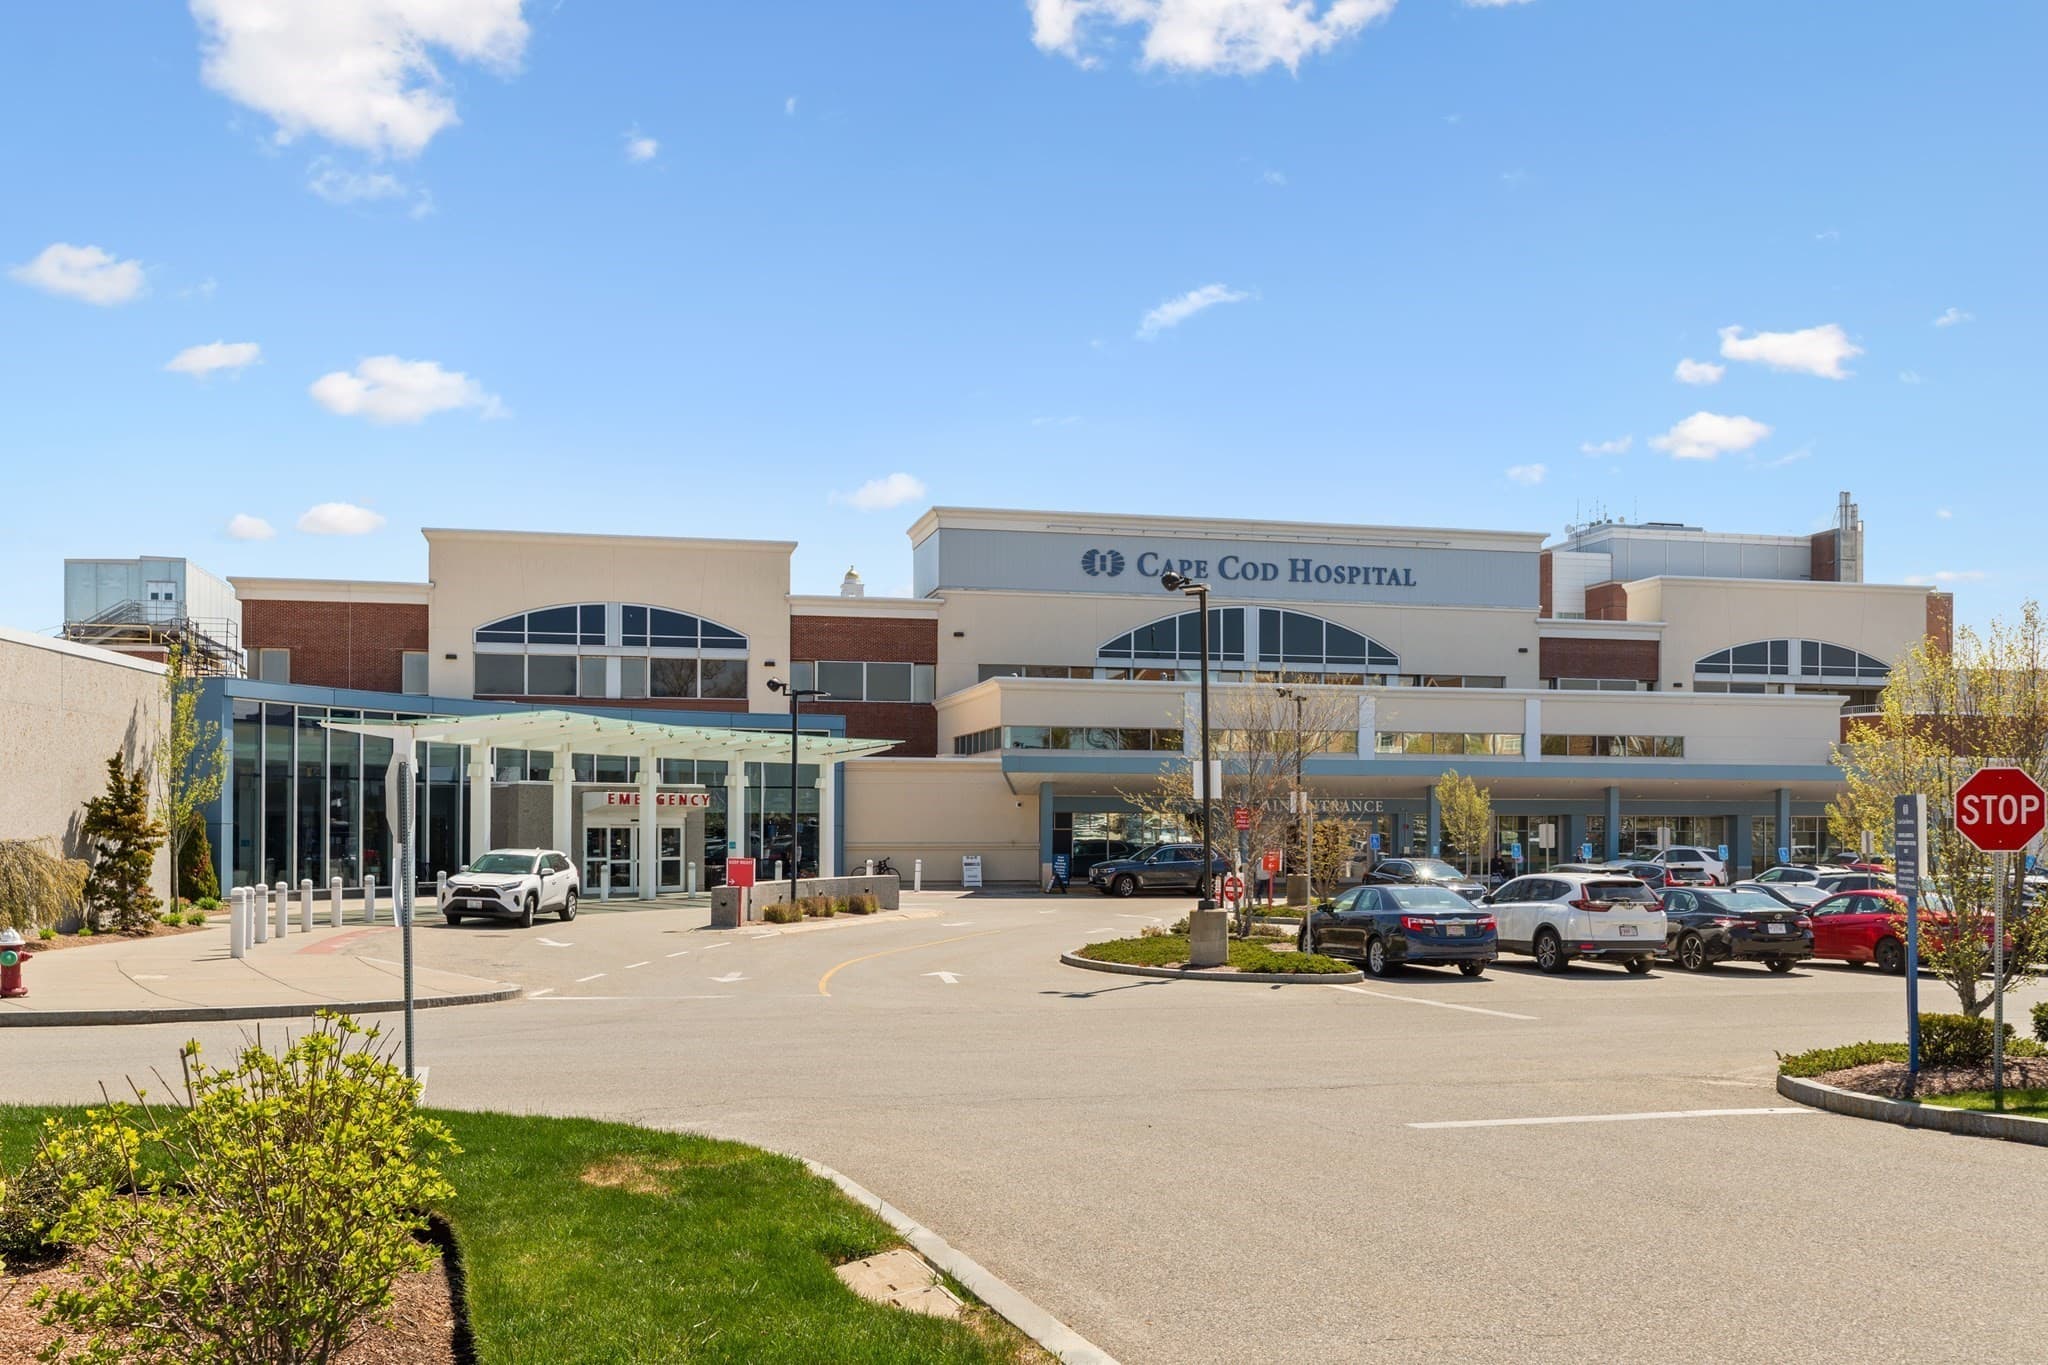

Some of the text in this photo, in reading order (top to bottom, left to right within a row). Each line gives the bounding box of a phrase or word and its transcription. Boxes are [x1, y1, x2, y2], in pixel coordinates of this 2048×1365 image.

[1137, 552, 1417, 587] CAPE COD HOSPITAL
[608, 793, 710, 806] EMEGENCY
[1306, 800, 1384, 813] NTRANCE
[1961, 794, 2040, 825] STOP
